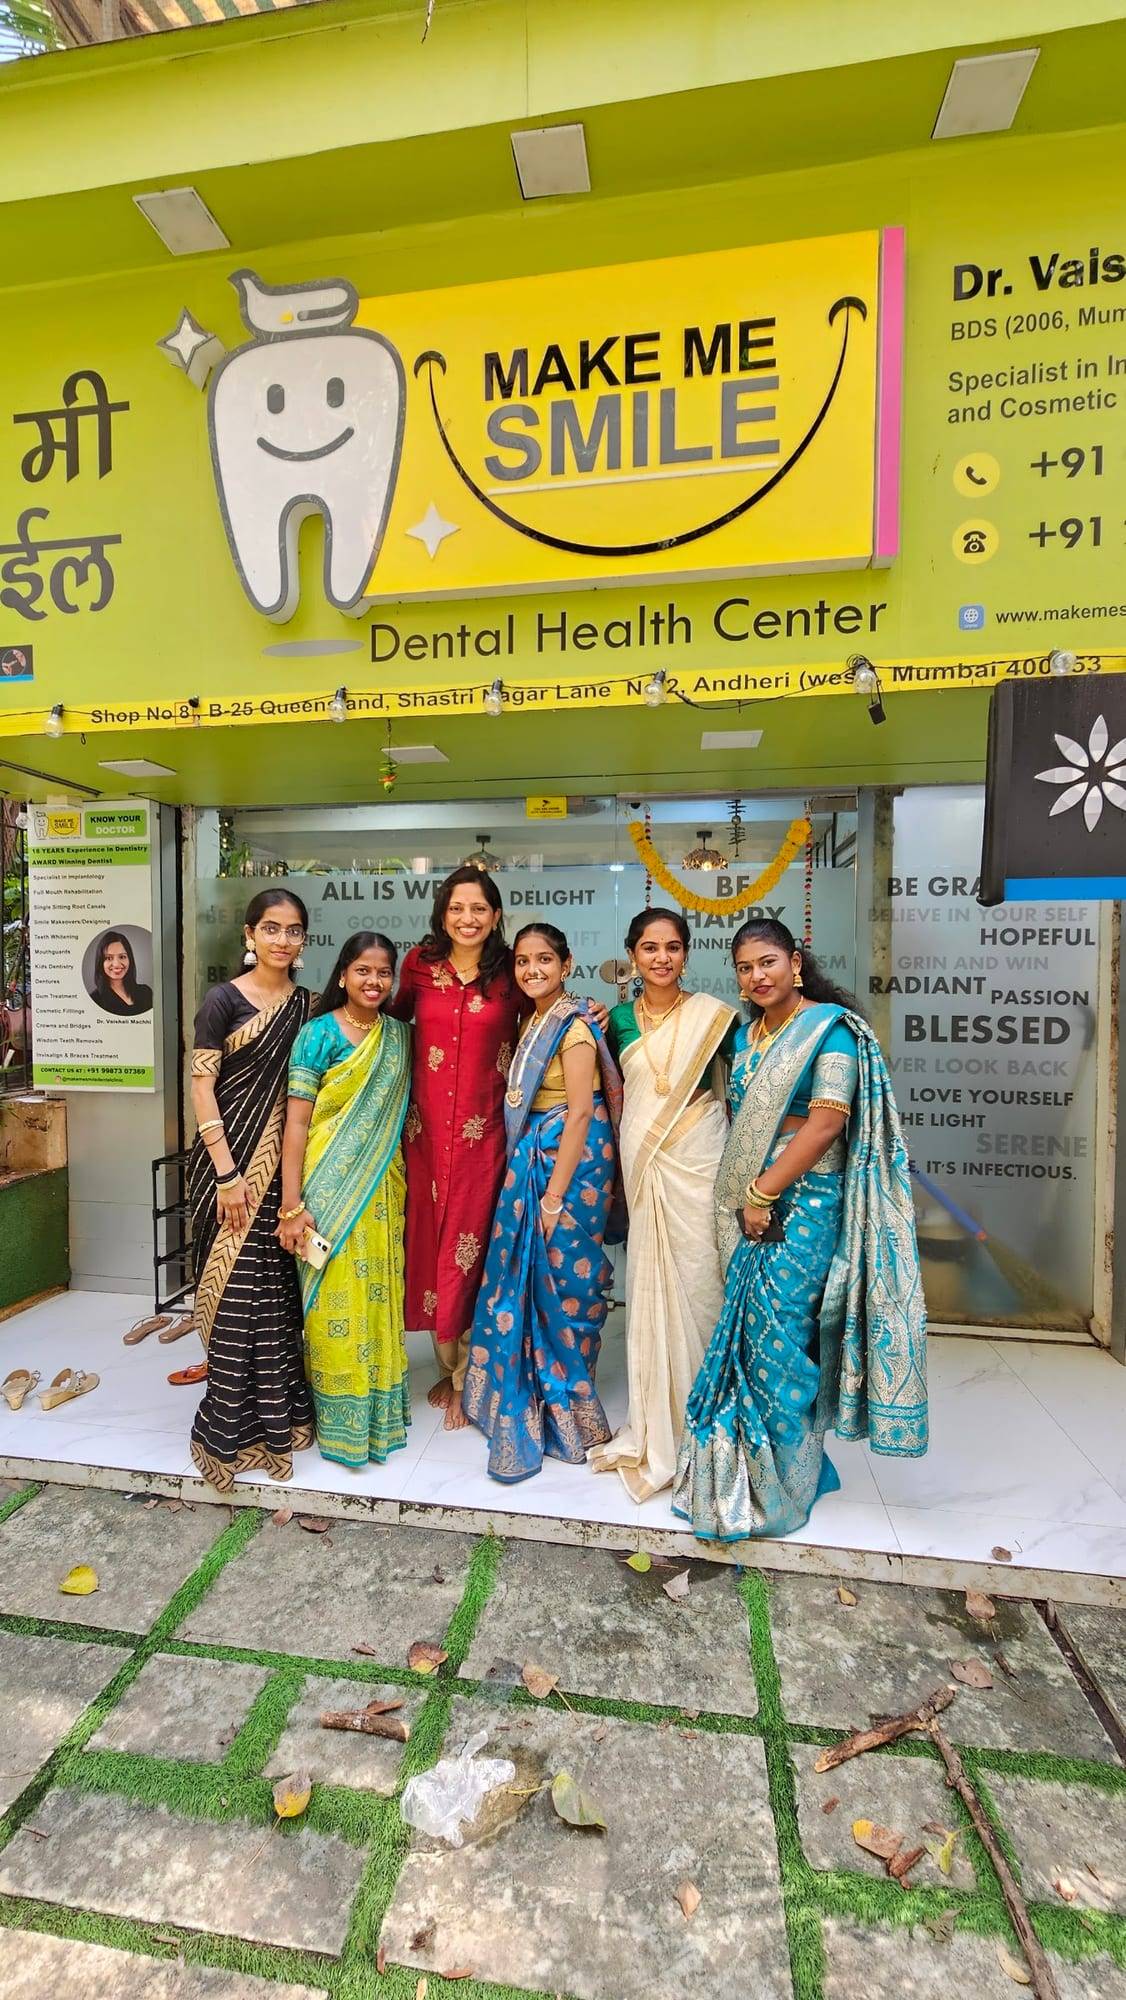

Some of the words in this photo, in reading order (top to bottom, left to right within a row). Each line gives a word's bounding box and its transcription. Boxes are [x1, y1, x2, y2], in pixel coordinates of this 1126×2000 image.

[953, 262, 1012, 301] Dr.
[1029, 247, 1126, 291] Vais
[951, 318, 998, 341] BDS
[1005, 311, 1070, 340] (2006,
[483, 332, 661, 401] MAKE
[683, 316, 777, 378] ME
[948, 360, 1068, 396] Specialist
[1077, 358, 1098, 380] in
[948, 400, 991, 424] and
[1000, 389, 1118, 420] Cosmetic
[13, 369, 130, 483] मी
[484, 375, 781, 482] SMILE
[1030, 445, 1103, 479] +91
[1029, 516, 1101, 549] +91
[371, 614, 514, 663] Dental
[537, 603, 691, 653] Health
[714, 598, 888, 642] Center
[91, 708, 140, 725] Shop
[209, 702, 253, 718] B-25
[398, 688, 473, 708] Shastri
[556, 684, 611, 700] Lane
[694, 671, 790, 692] Andheri
[799, 668, 855, 692] (wes
[893, 662, 996, 682] Mumbai
[1006, 656, 1101, 676] 40053
[90, 815, 116, 823] KNOW
[118, 815, 141, 823] YOUR
[96, 826, 136, 834] DOCTOR
[115, 845, 148, 853] Dentistry
[322, 880, 364, 901] ALL
[373, 880, 395, 900] IS
[888, 877, 918, 897] BE
[510, 890, 595, 906] DELIGHT
[347, 915, 403, 930] GOOD
[868, 907, 941, 922] BELIEVE
[949, 907, 970, 922] IN
[979, 907, 1037, 922] YOUR
[1045, 907, 1088, 922] SELF
[980, 927, 1096, 946] HOPEFUL
[897, 956, 947, 970] GRIN
[953, 956, 998, 970] AND
[1006, 956, 1048, 970] WIN
[868, 976, 987, 995] RADIANT
[991, 989, 1089, 1006] PASSION
[905, 1014, 1071, 1045] BLESSED
[935, 1059, 998, 1075] LOOK
[1008, 1060, 1069, 1077] BACK
[910, 1088, 961, 1103] LOVE
[968, 1089, 1074, 1106] YOURSELF
[898, 1112, 924, 1126] HE
[931, 1113, 986, 1128] LIGHT
[976, 1132, 1088, 1157] SERENE
[927, 1161, 956, 1175] IT'S
[963, 1162, 1077, 1181] INFECTIOUS.
